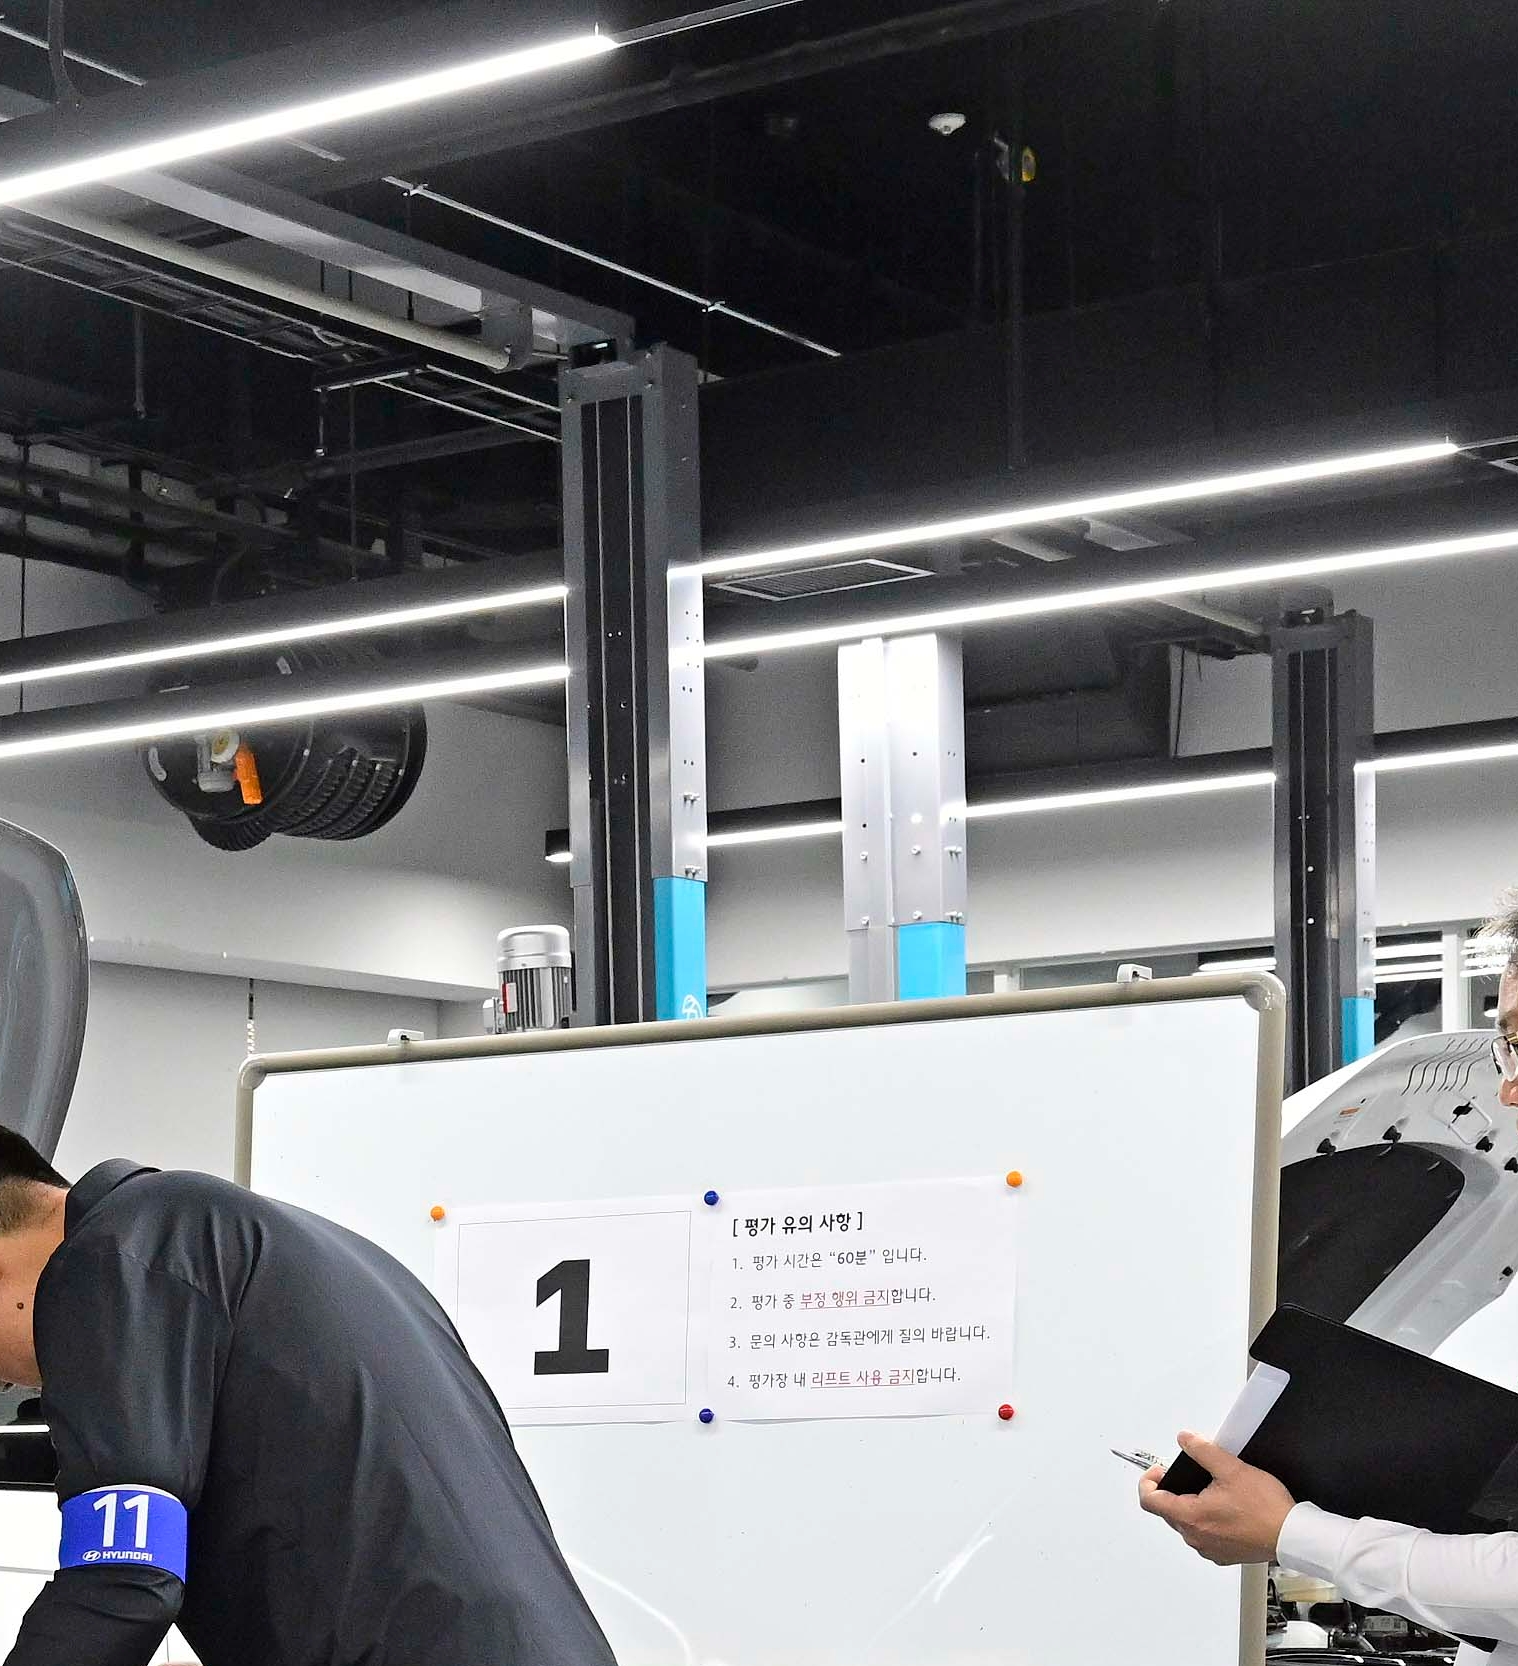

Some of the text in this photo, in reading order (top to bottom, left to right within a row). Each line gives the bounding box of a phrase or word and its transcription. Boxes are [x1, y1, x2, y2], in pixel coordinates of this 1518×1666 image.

[744, 1217, 776, 1237] 평가
[781, 1215, 813, 1235] 유의
[819, 1212, 852, 1232] 사항
[732, 1258, 743, 1270] 1.
[752, 1255, 779, 1271] 평가
[783, 1252, 824, 1269] 시간은
[882, 1247, 927, 1264] 입니다.
[730, 1287, 936, 1310] 2. 평가 중 부정 행위 금지합니다.
[533, 1258, 610, 1376] 1
[729, 1325, 990, 1350] 3. 문의 사항은 감독관에게 질의 바랍니다.
[727, 1367, 961, 1390] 4. 평가장 내 리프트 사용 금지합니다.
[92, 1492, 150, 1549] 11
[102, 1550, 153, 1562] HYUNDAI
